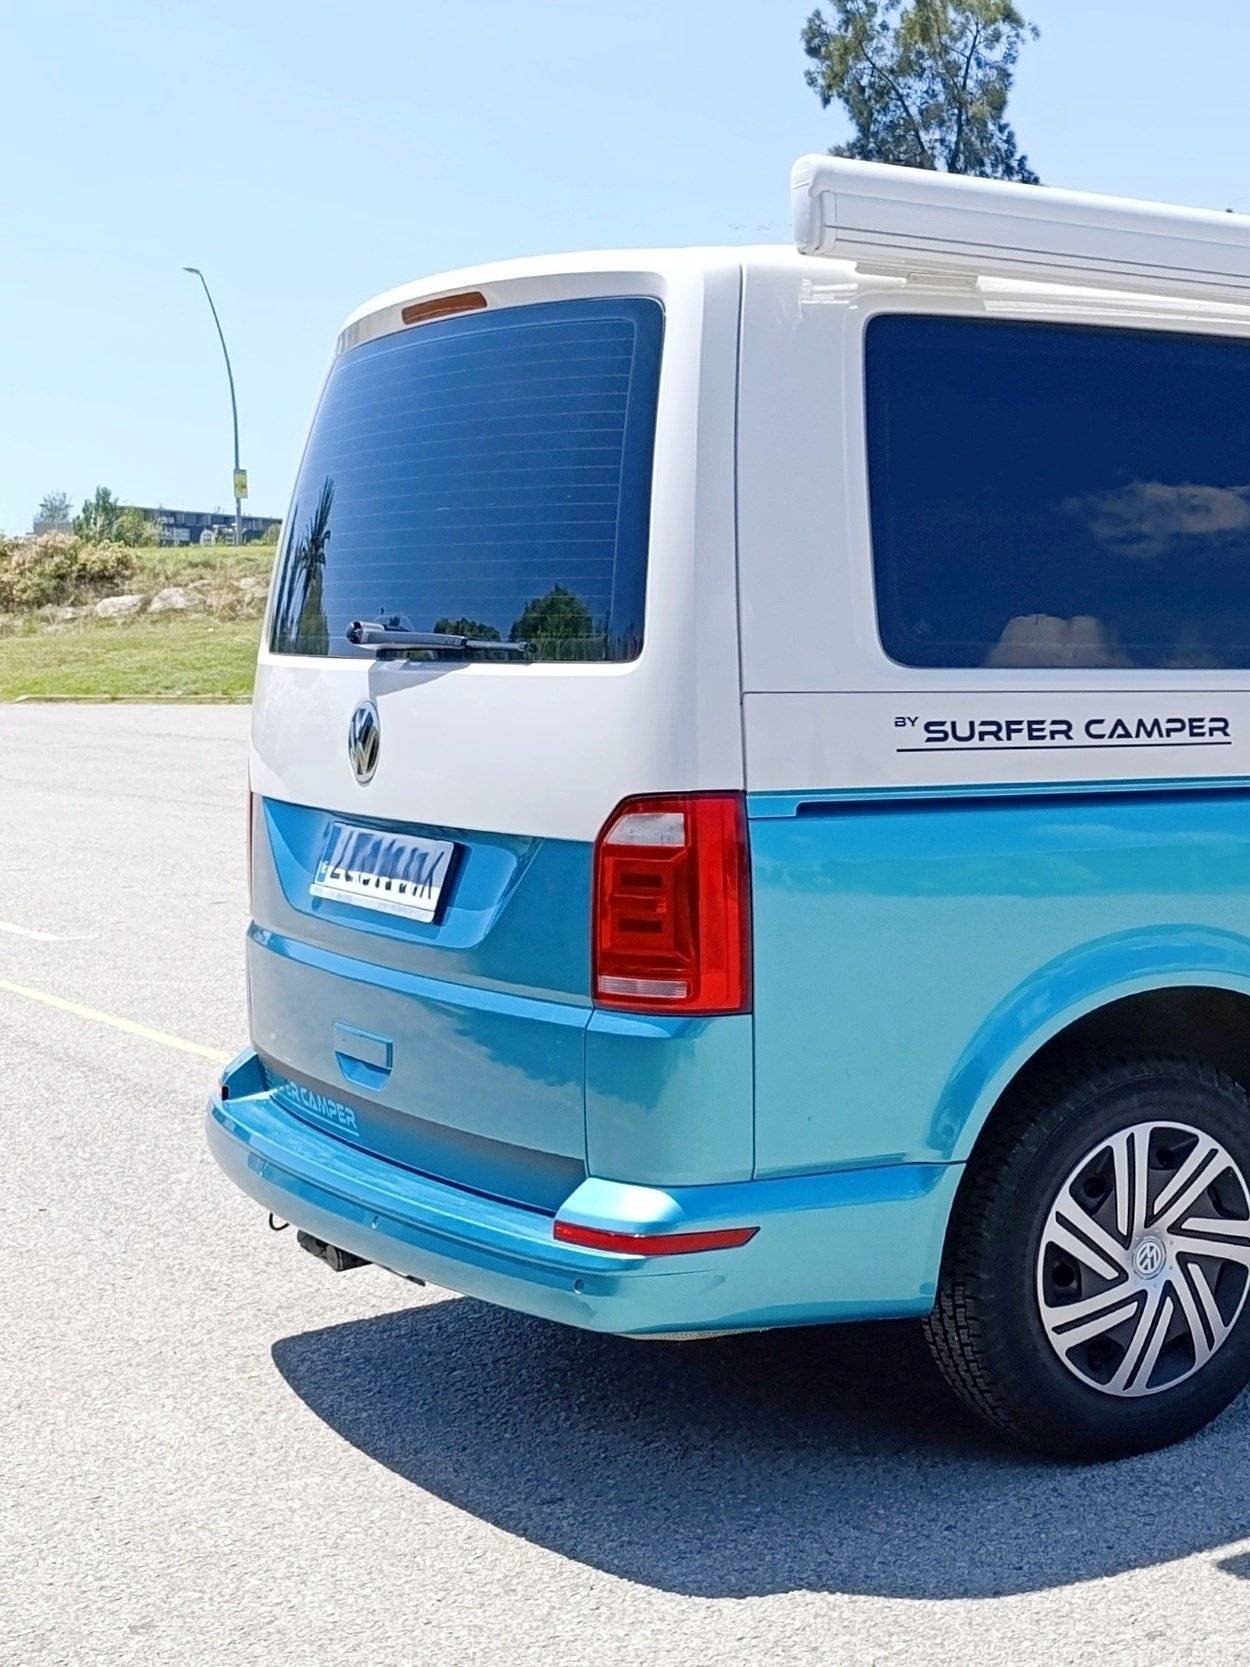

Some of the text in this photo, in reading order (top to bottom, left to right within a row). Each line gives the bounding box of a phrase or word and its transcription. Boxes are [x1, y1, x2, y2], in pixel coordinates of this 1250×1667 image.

[894, 716, 1230, 743] BY SURFER CAMPER
[300, 1087, 357, 1128] CAMPER
